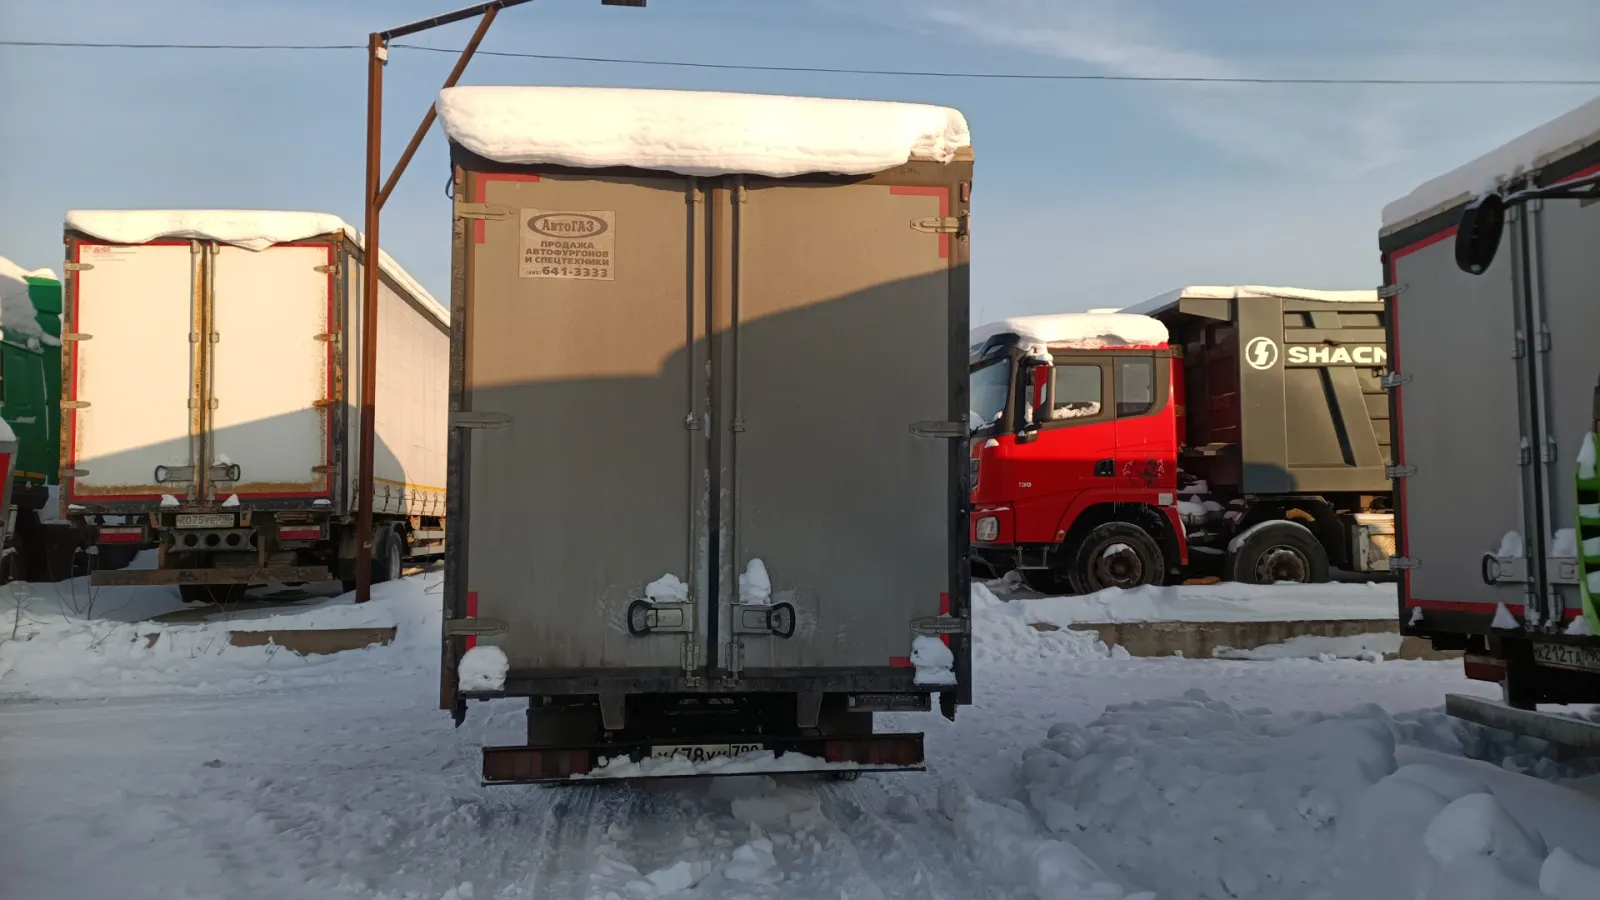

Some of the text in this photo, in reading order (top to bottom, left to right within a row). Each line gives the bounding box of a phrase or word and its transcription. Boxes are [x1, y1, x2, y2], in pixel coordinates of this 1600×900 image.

[541, 219, 594, 232] АвтоГАЗ
[540, 241, 594, 249] ПРОДАЖА
[525, 248, 609, 257] АВТОФУРГОНОВ
[534, 256, 609, 265] СПЕЦТЕХНИКИ
[541, 266, 608, 278] 641-3333
